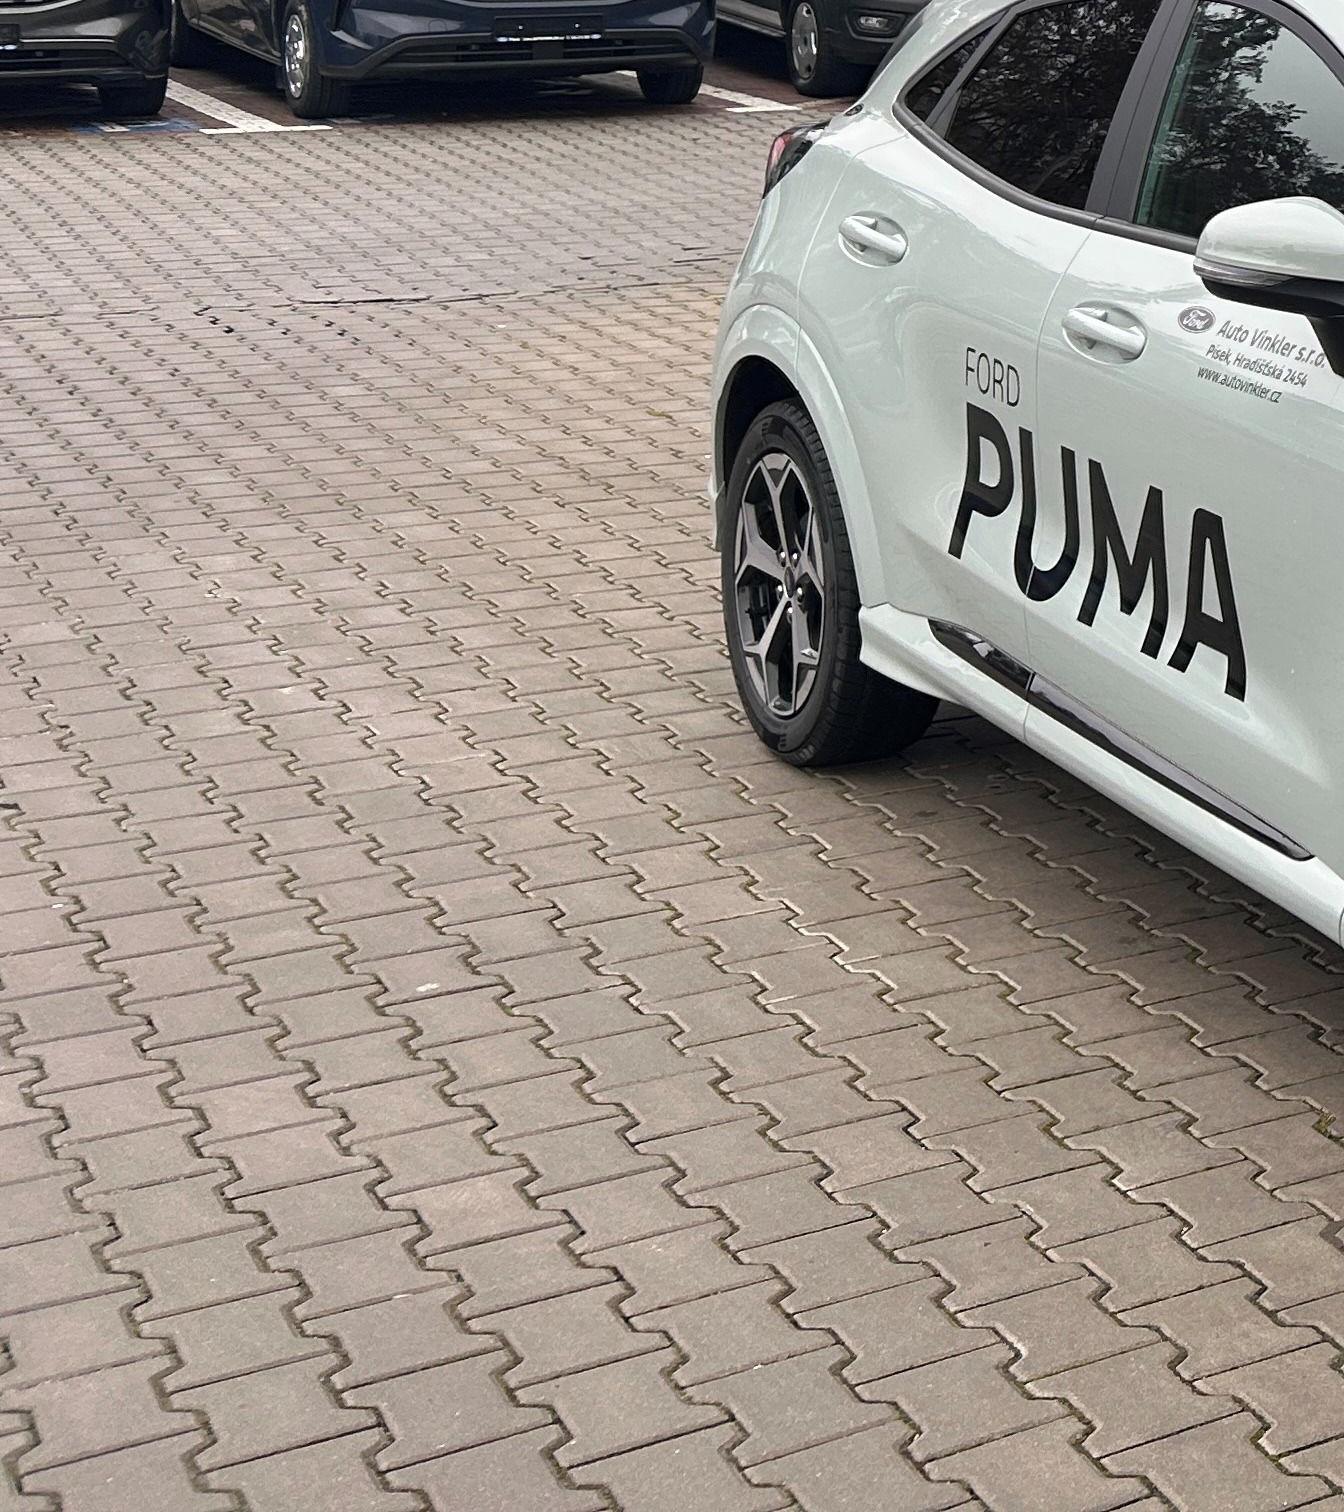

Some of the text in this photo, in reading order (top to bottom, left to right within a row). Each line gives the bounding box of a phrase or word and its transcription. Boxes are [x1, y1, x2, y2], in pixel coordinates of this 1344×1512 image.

[1217, 320, 1250, 344] Auto
[1250, 328, 1297, 358] Vinkler
[964, 346, 1021, 408] FORD
[1197, 366, 1283, 404] www.autovinkler.cz
[1283, 368, 1309, 388] 2454
[947, 401, 1248, 703] PUMA
